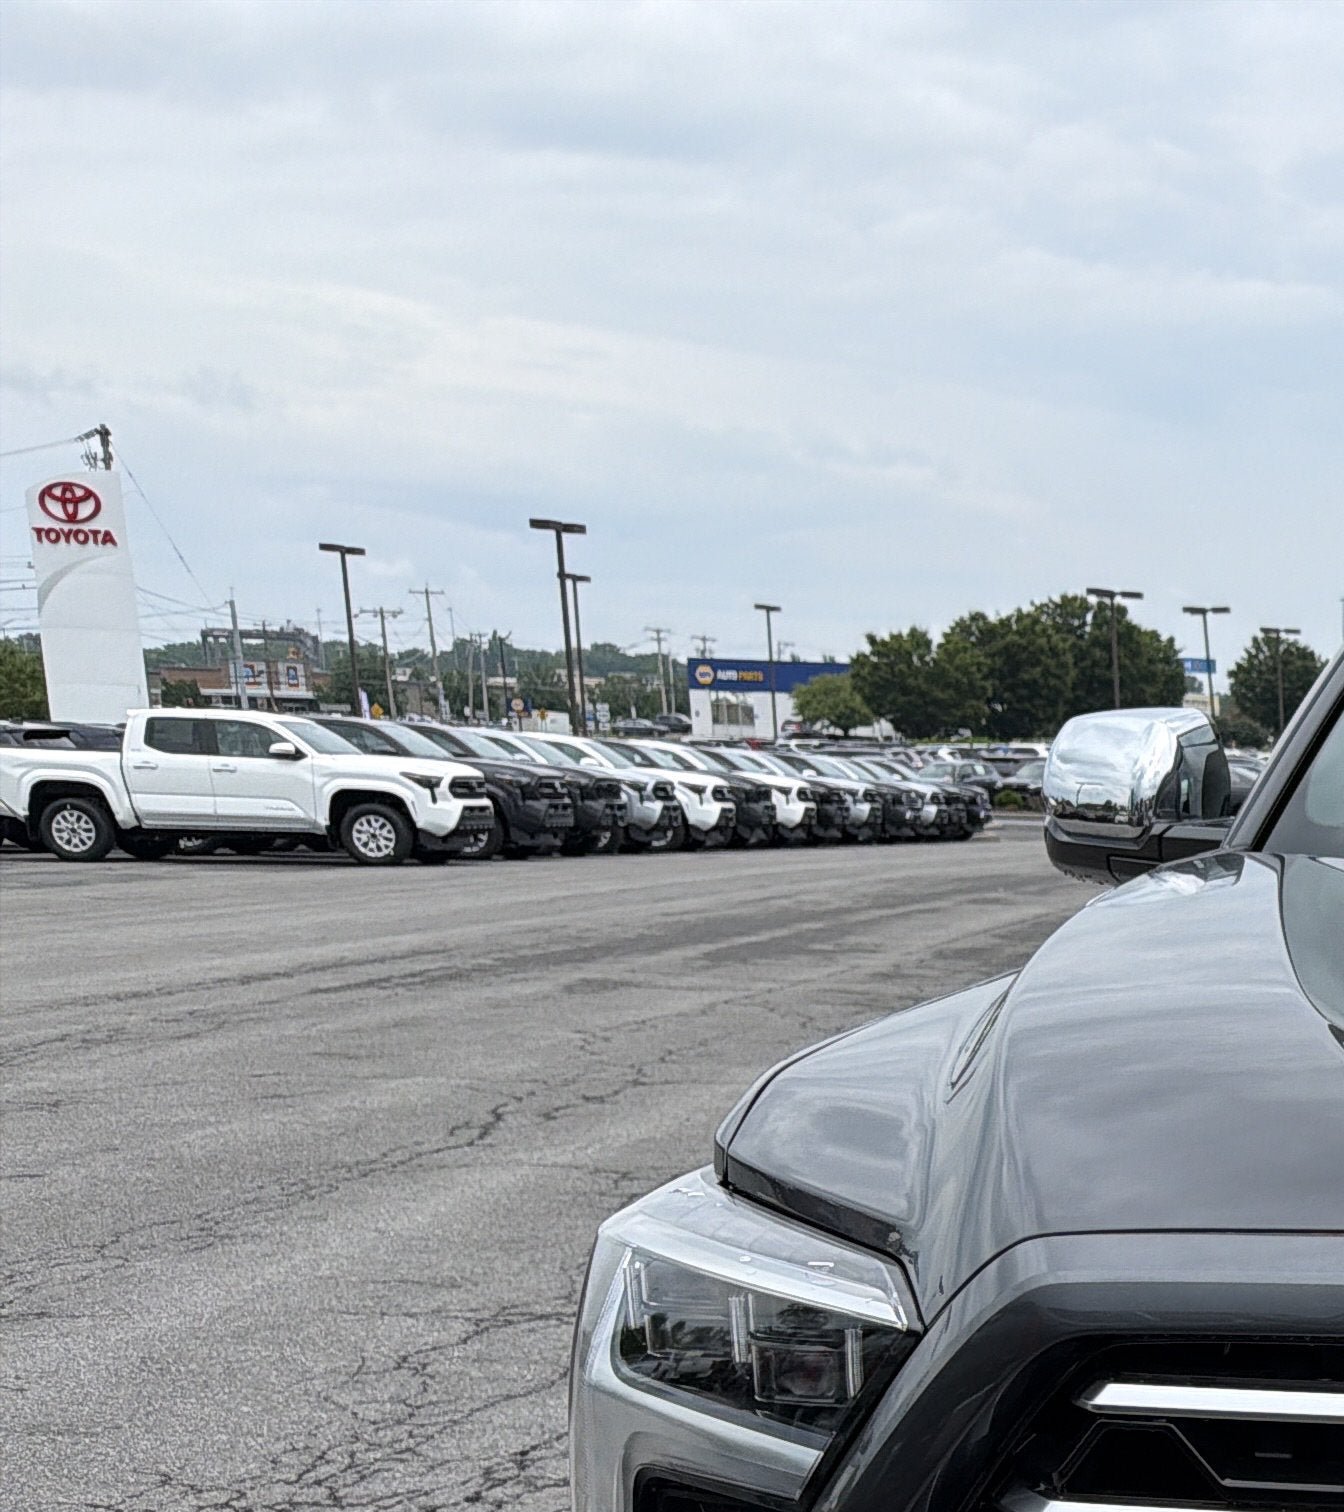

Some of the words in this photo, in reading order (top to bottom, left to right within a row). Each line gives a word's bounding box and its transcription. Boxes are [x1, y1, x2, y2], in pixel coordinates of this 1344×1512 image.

[31, 527, 118, 546] TOYOTA
[717, 670, 738, 681] AUTO
[739, 671, 763, 682] PARTS
